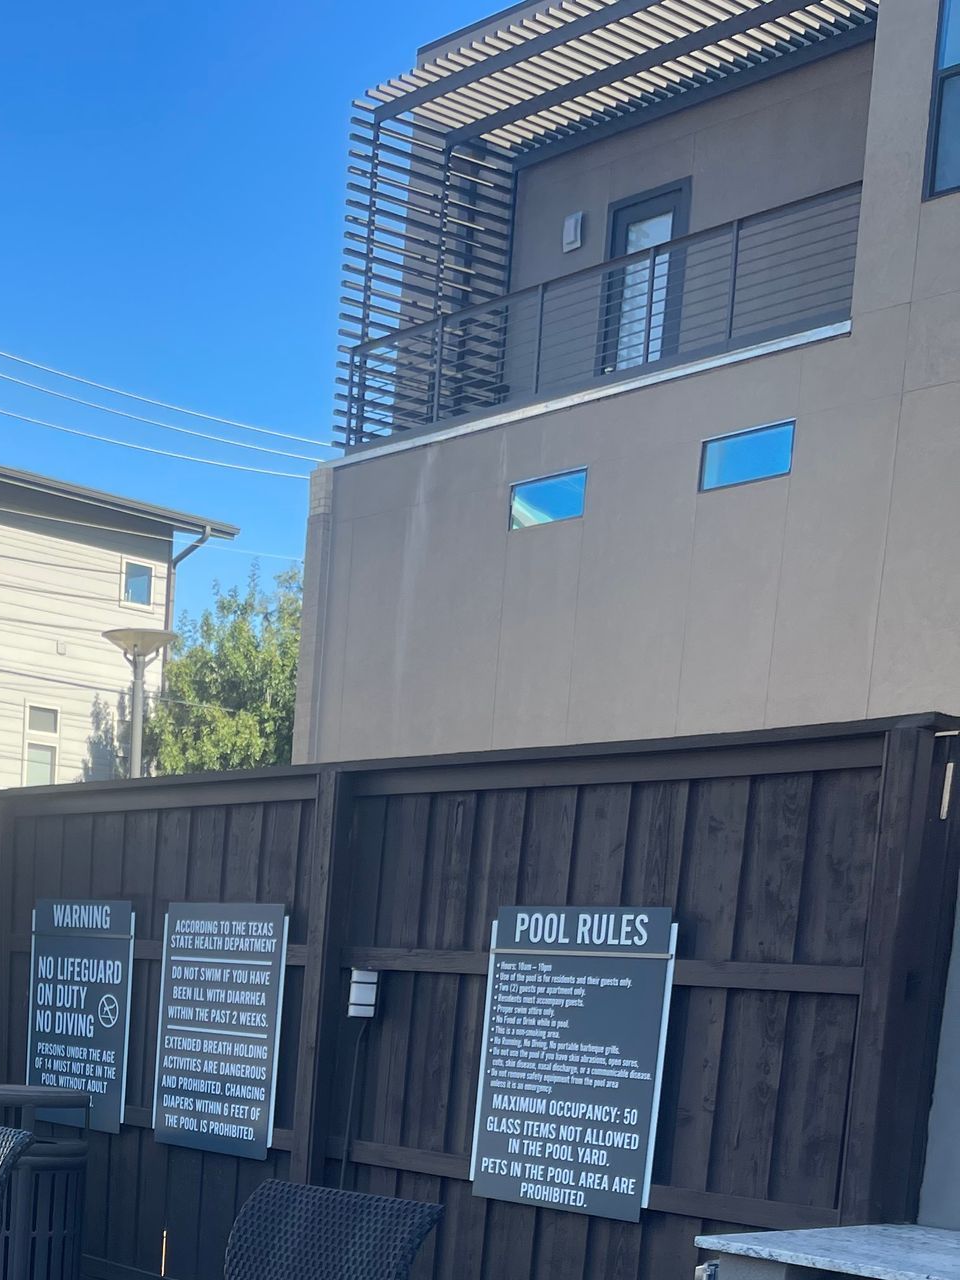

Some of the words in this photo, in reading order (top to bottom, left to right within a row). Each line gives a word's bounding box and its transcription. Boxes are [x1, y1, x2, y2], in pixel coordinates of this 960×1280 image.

[53, 904, 110, 929] WARNING
[175, 920, 218, 934] ACCORDING
[220, 921, 230, 935] TO
[232, 921, 246, 935] THE
[248, 922, 273, 936] TEXAS
[515, 913, 569, 943] POOL
[577, 914, 648, 945] RULES
[171, 935, 193, 948] STATE
[195, 936, 223, 950] HEALTH
[224, 937, 277, 952] DEPARTMENT
[38, 956, 54, 979] NO
[58, 957, 122, 984] LIFEGUARD
[172, 966, 182, 979] DO
[184, 967, 199, 980] NOT
[200, 968, 221, 982] SWIM
[223, 969, 230, 982] IF
[232, 970, 248, 983] YOU
[249, 971, 271, 985] HAVE
[37, 983, 53, 1006] ON
[56, 984, 87, 1009] DUTY
[173, 986, 192, 1000] BEEN
[194, 987, 204, 1001] ILL
[207, 988, 226, 1002] WITH
[227, 990, 266, 1006] DIARRHEA
[36, 1009, 51, 1032] NO
[55, 1011, 94, 1037] DIVING
[168, 1006, 193, 1020] WITHIN
[195, 1008, 209, 1021] THE
[211, 1009, 231, 1023] PAST
[232, 1011, 238, 1024] 2
[240, 1012, 268, 1027] WEEKS.
[37, 1042, 65, 1057] PERSONS
[66, 1046, 87, 1060] UNDER
[89, 1048, 101, 1061] THE
[102, 1050, 115, 1063] AGE
[165, 1036, 201, 1051] EXTENDED
[203, 1040, 232, 1055] BREATH
[233, 1043, 268, 1059] HOLDING
[35, 1057, 43, 1068] OF
[45, 1058, 51, 1070] 14
[53, 1059, 71, 1072] MUST
[72, 1062, 85, 1074] NOT
[86, 1064, 94, 1076] BE
[95, 1065, 102, 1077] IN
[104, 1066, 116, 1079] THE
[163, 1055, 201, 1072] ACTIVITIES
[203, 1060, 218, 1074] ARE
[220, 1062, 266, 1080] DANGEROUS
[42, 1073, 57, 1086] POOL
[59, 1075, 86, 1090] WITHOUT
[87, 1079, 107, 1094] ADULT
[161, 1074, 177, 1088] AND
[178, 1076, 223, 1095] PROHIBITED.
[225, 1083, 265, 1101] CHANGING
[163, 1094, 193, 1110] DIAPERS
[196, 1099, 222, 1115] WITHIN
[223, 1103, 228, 1116] 6
[230, 1104, 249, 1119] FEET
[250, 1106, 261, 1121] OF
[492, 1094, 546, 1114] MAXIMUM
[549, 1100, 620, 1123] OCCUPANCY:
[623, 1108, 638, 1125] 50
[165, 1113, 178, 1128] THE
[179, 1116, 198, 1131] POOL
[200, 1120, 207, 1132] IS
[209, 1121, 255, 1141] PROHIBITED.
[487, 1116, 521, 1134] GLASS
[523, 1121, 556, 1139] ITEMS
[559, 1125, 583, 1142] NOT
[584, 1128, 639, 1149] ALLOWED
[508, 1138, 520, 1154] IN
[523, 1140, 543, 1157] THE
[545, 1143, 573, 1161] POOL
[578, 1147, 609, 1166] YARD.
[481, 1157, 507, 1175] PETS
[510, 1161, 522, 1177] IN
[525, 1163, 545, 1180] THE
[547, 1167, 575, 1185] POOL
[578, 1172, 608, 1190] AREA
[612, 1177, 636, 1194] ARE
[520, 1182, 587, 1207] PROHIBITED.
